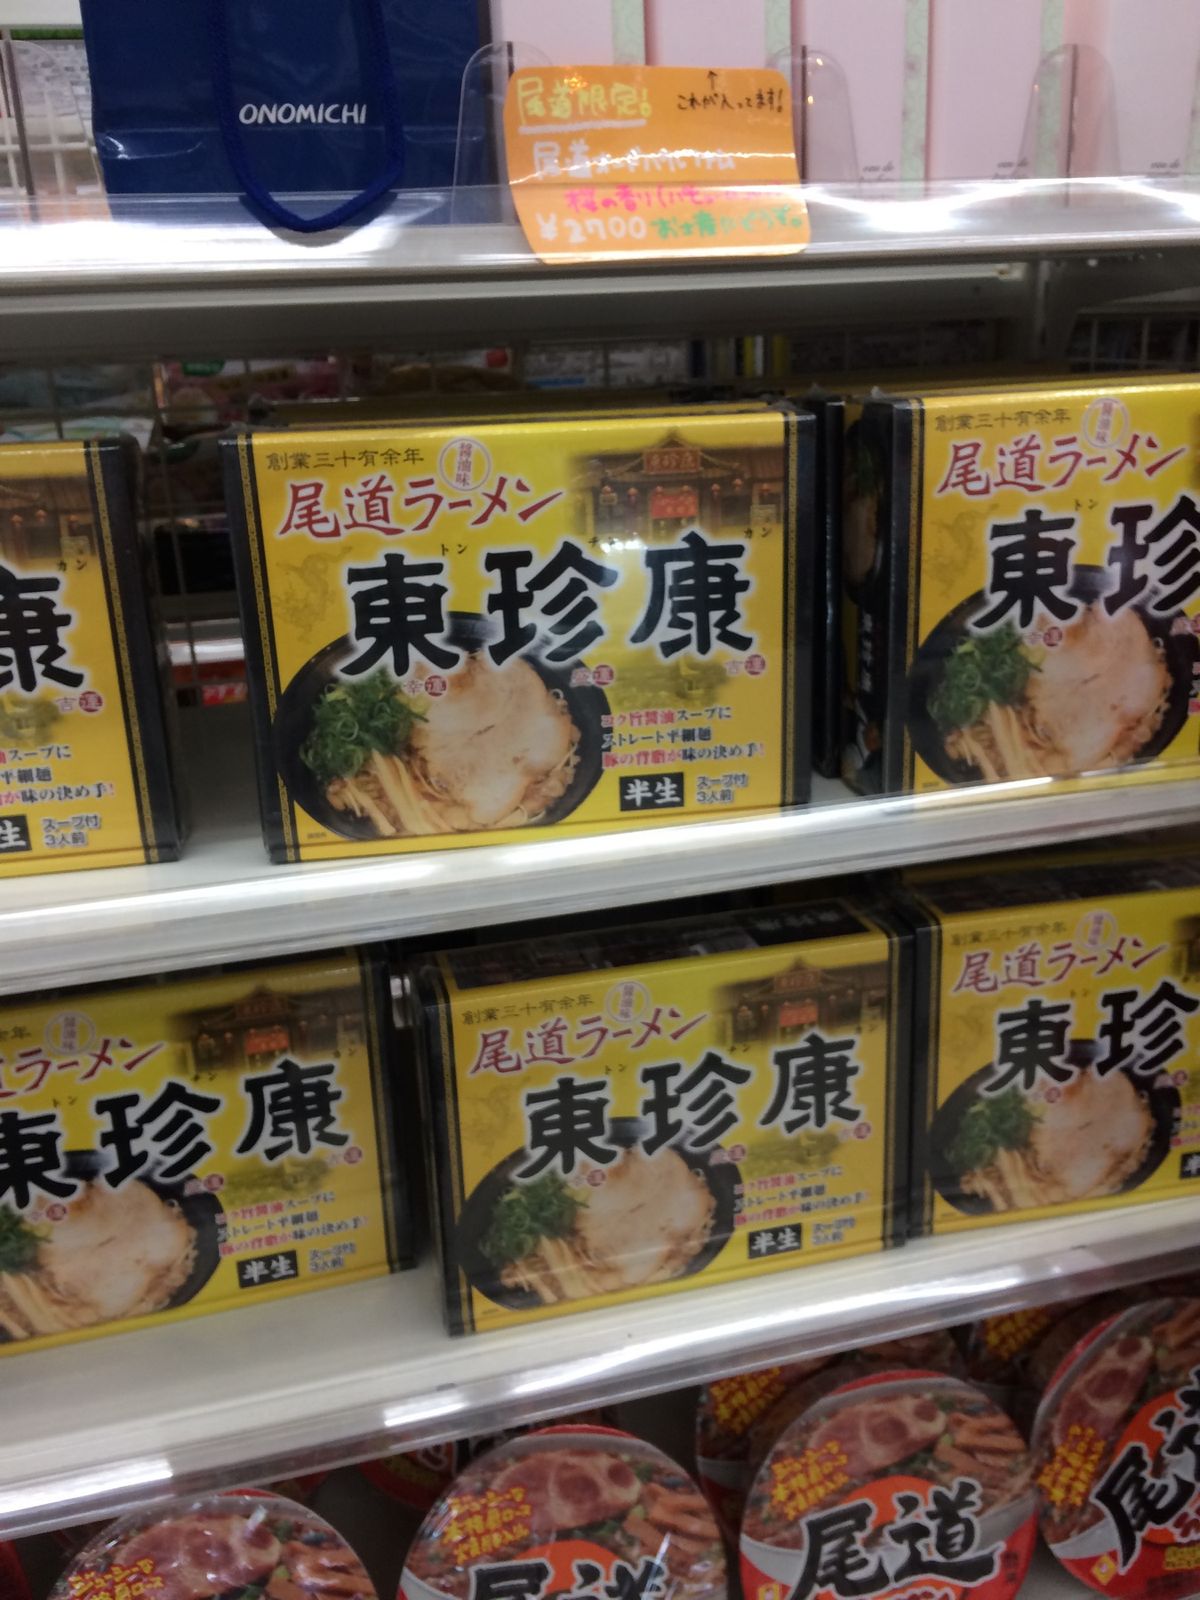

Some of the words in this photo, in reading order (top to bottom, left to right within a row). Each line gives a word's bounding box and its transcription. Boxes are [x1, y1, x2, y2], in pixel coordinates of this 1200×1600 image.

[239, 103, 367, 125] ONOMICHI
[536, 213, 648, 243] ¥2700
[266, 447, 425, 471] 創業三十有余年
[937, 434, 1187, 496] 尾道ラーメン
[279, 474, 563, 538] 尾道ラーメン
[340, 531, 753, 677] 東珍康
[624, 777, 682, 807] 半生
[953, 937, 1168, 993] 尾道ラーメン
[0, 1038, 165, 1098] ラーメン
[470, 1007, 708, 1074] 尾道ラーメン
[516, 1032, 861, 1180] 東珍康
[243, 1254, 296, 1283] 半生
[752, 1227, 799, 1254] 半生
[785, 1480, 997, 1600] 尾道
